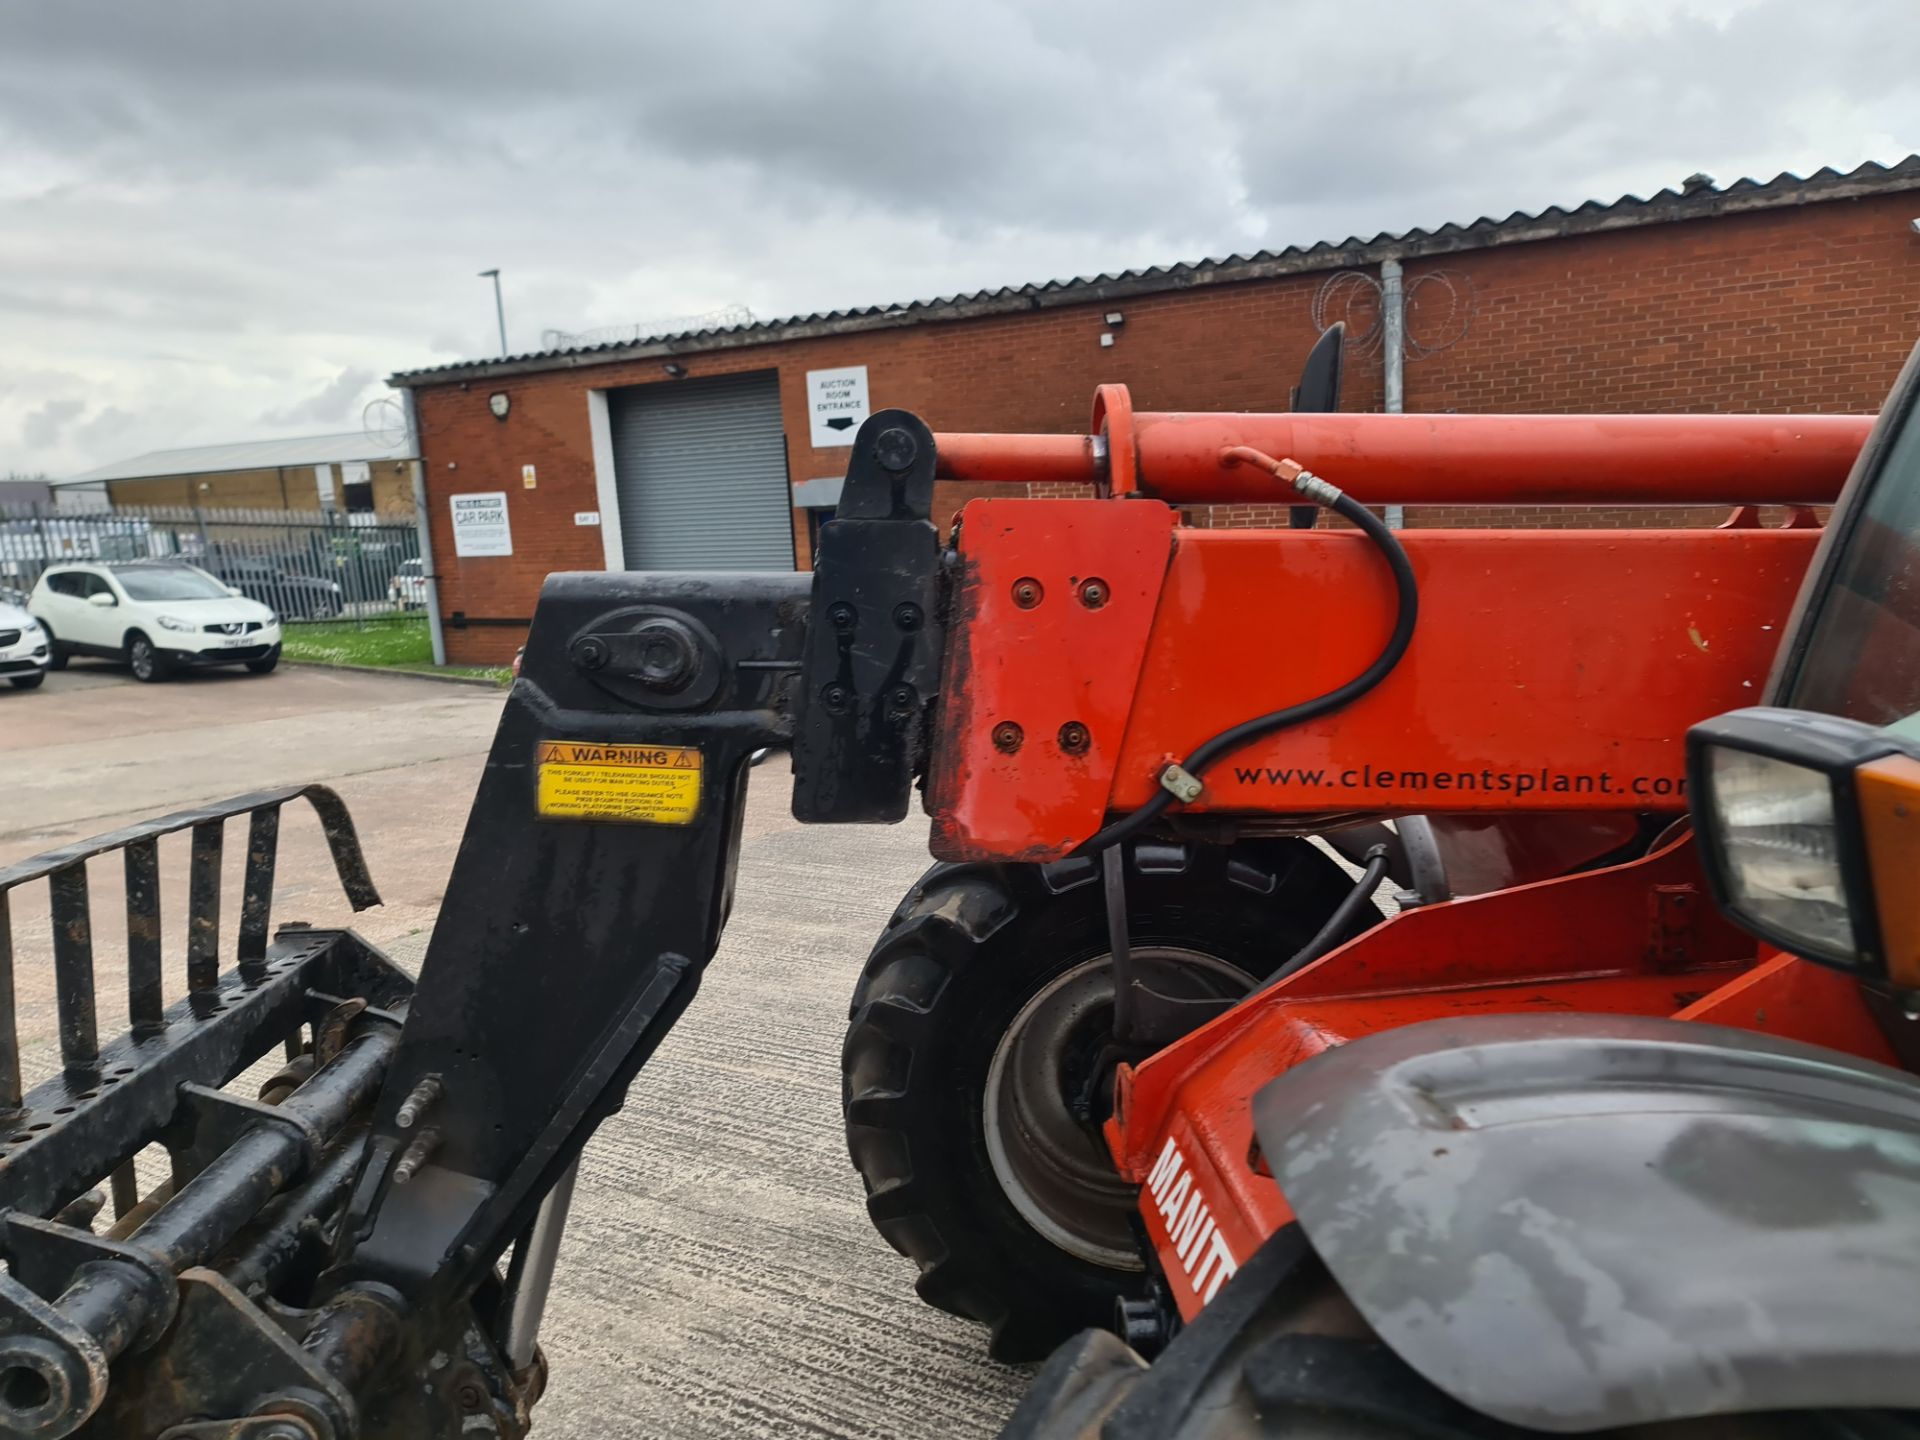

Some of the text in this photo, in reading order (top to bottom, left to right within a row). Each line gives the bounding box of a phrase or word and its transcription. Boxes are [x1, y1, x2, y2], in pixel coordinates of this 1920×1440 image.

[821, 379, 856, 388] AUCTION
[826, 391, 850, 399] ROOM
[817, 400, 861, 411] ENTRANCE
[455, 510, 505, 524] CAR PARK
[572, 747, 667, 765] WARNING
